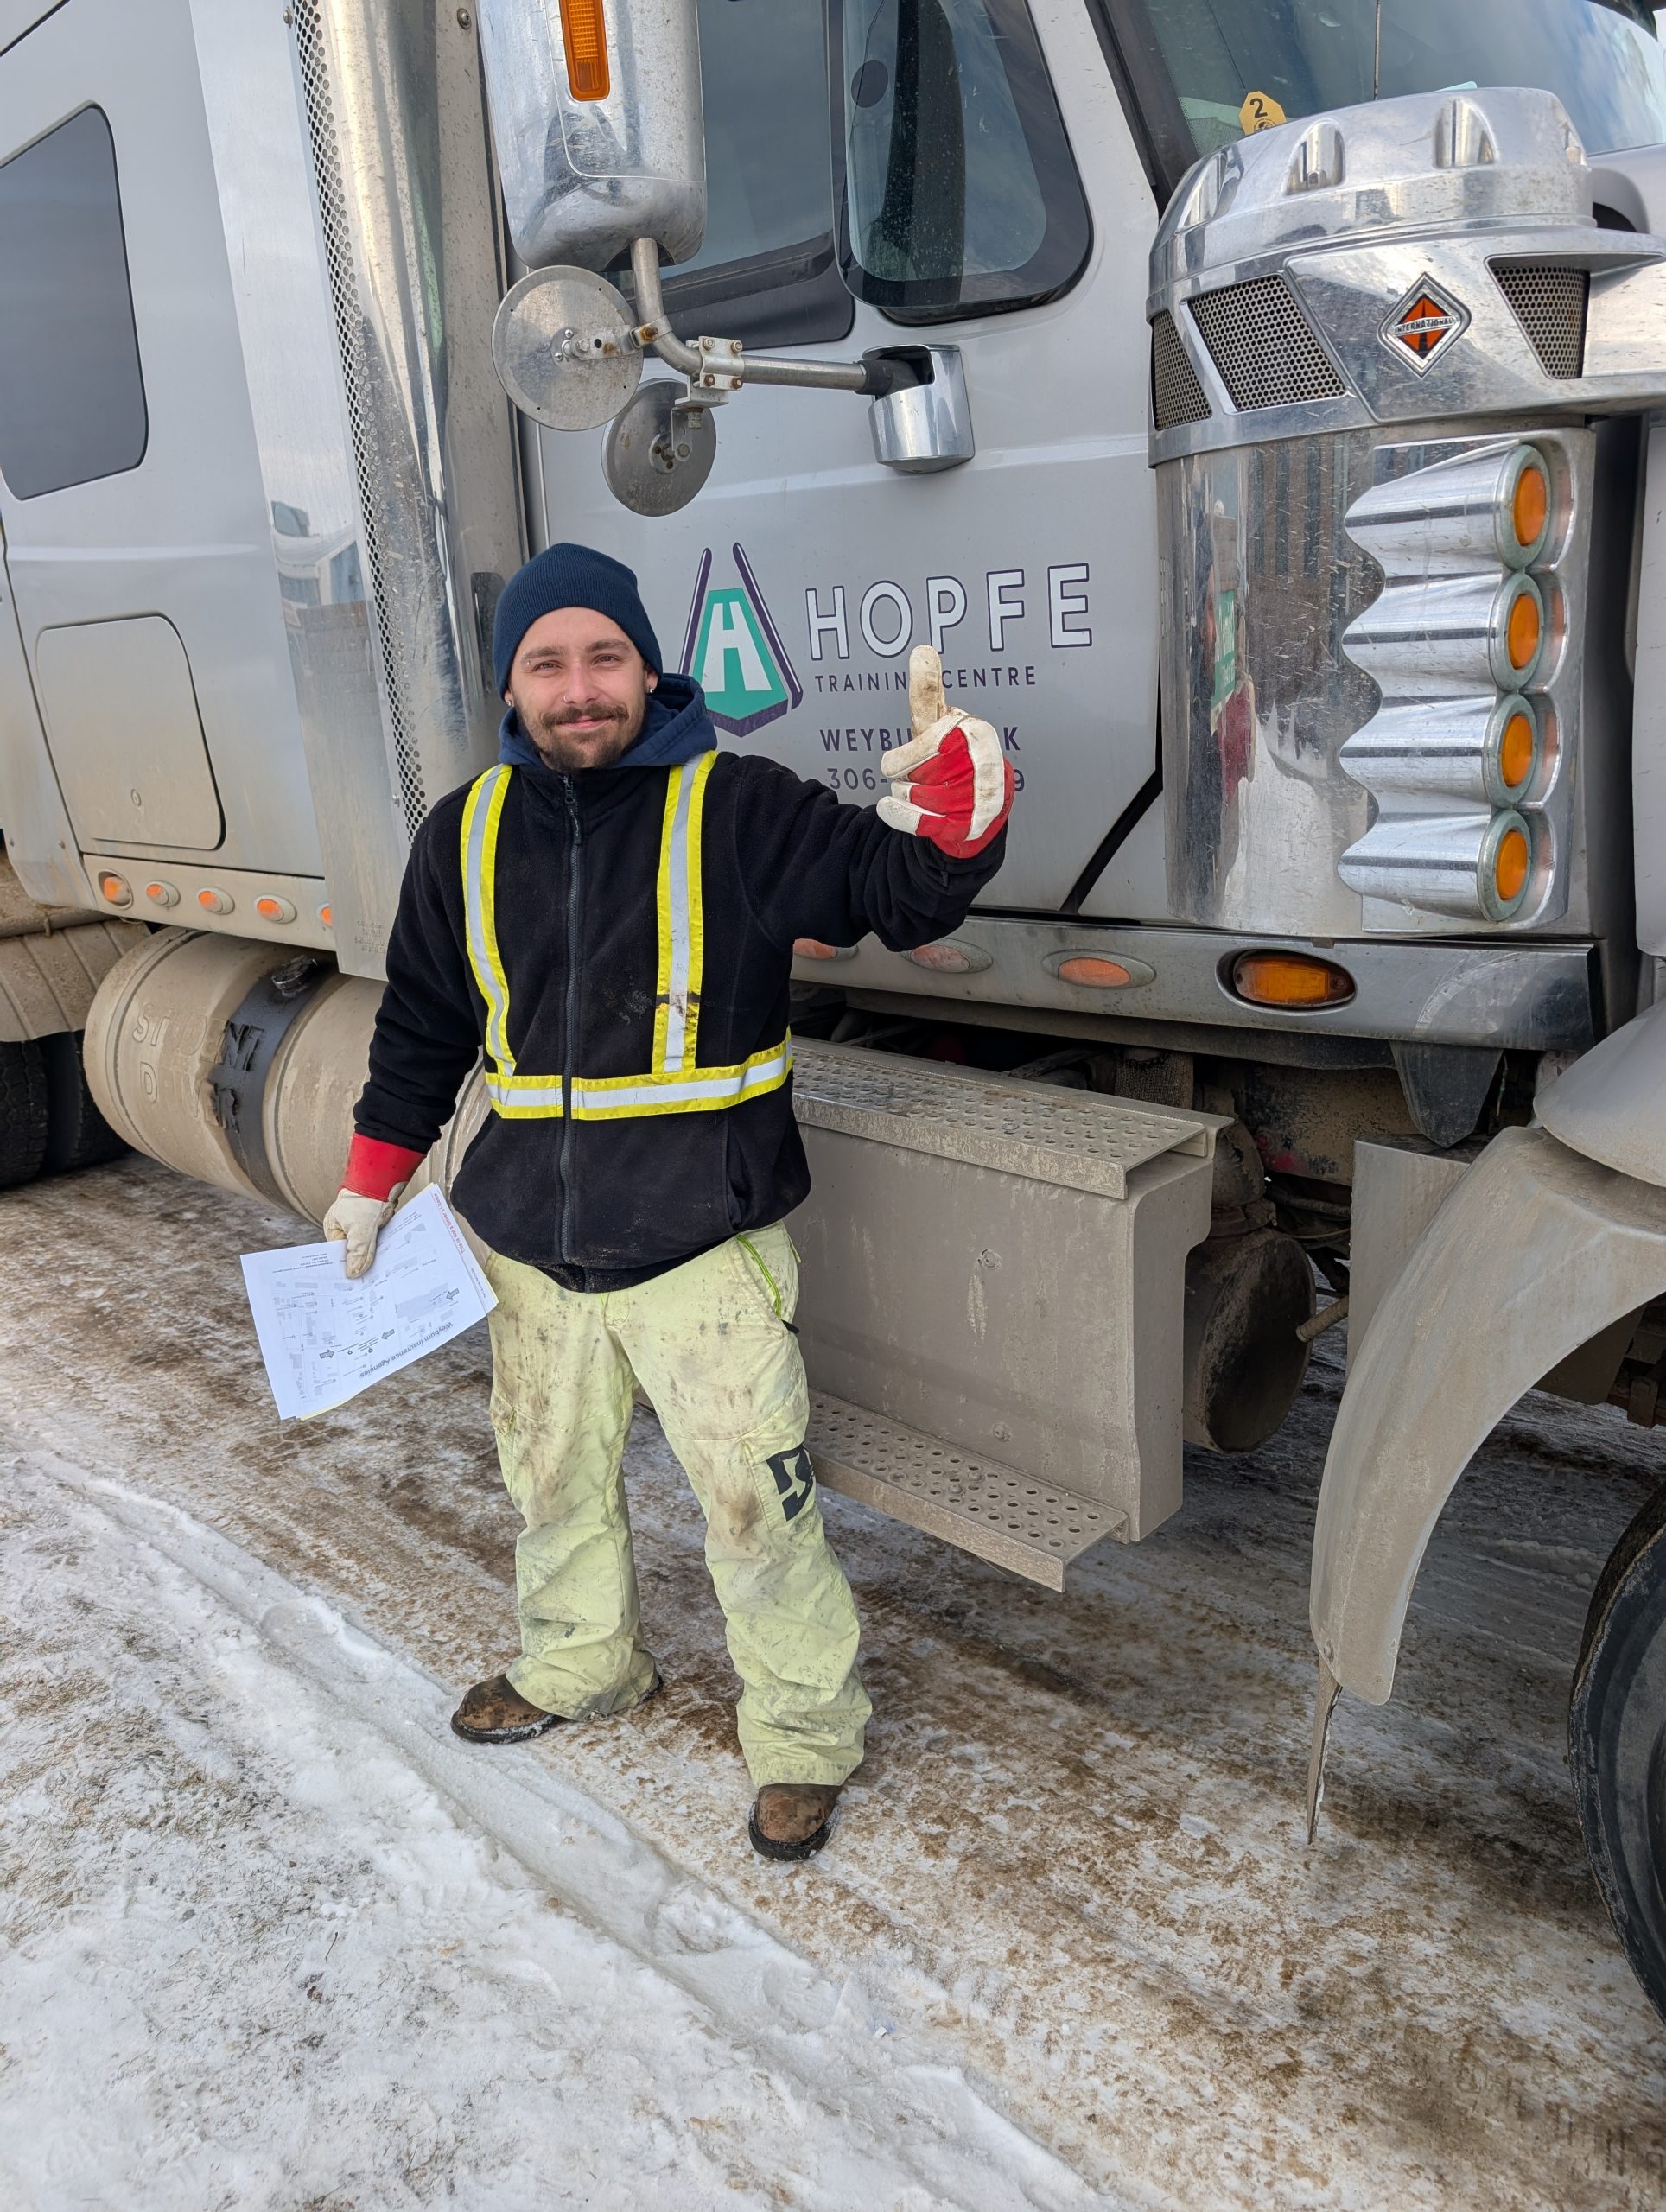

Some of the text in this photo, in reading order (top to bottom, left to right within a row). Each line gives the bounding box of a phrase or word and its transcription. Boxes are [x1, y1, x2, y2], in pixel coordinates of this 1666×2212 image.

[1250, 98, 1268, 118] 2
[1394, 317, 1455, 334] INTERNATIONAL
[805, 563, 1092, 661] HOPFE
[815, 665, 1036, 693] TRAININ CENTRE
[820, 728, 912, 752] WEYBU
[132, 1002, 264, 1071] STDENT
[423, 1322, 454, 1343] Weyburn
[391, 1339, 424, 1361] Insurance
[359, 1358, 391, 1378] Agencies
